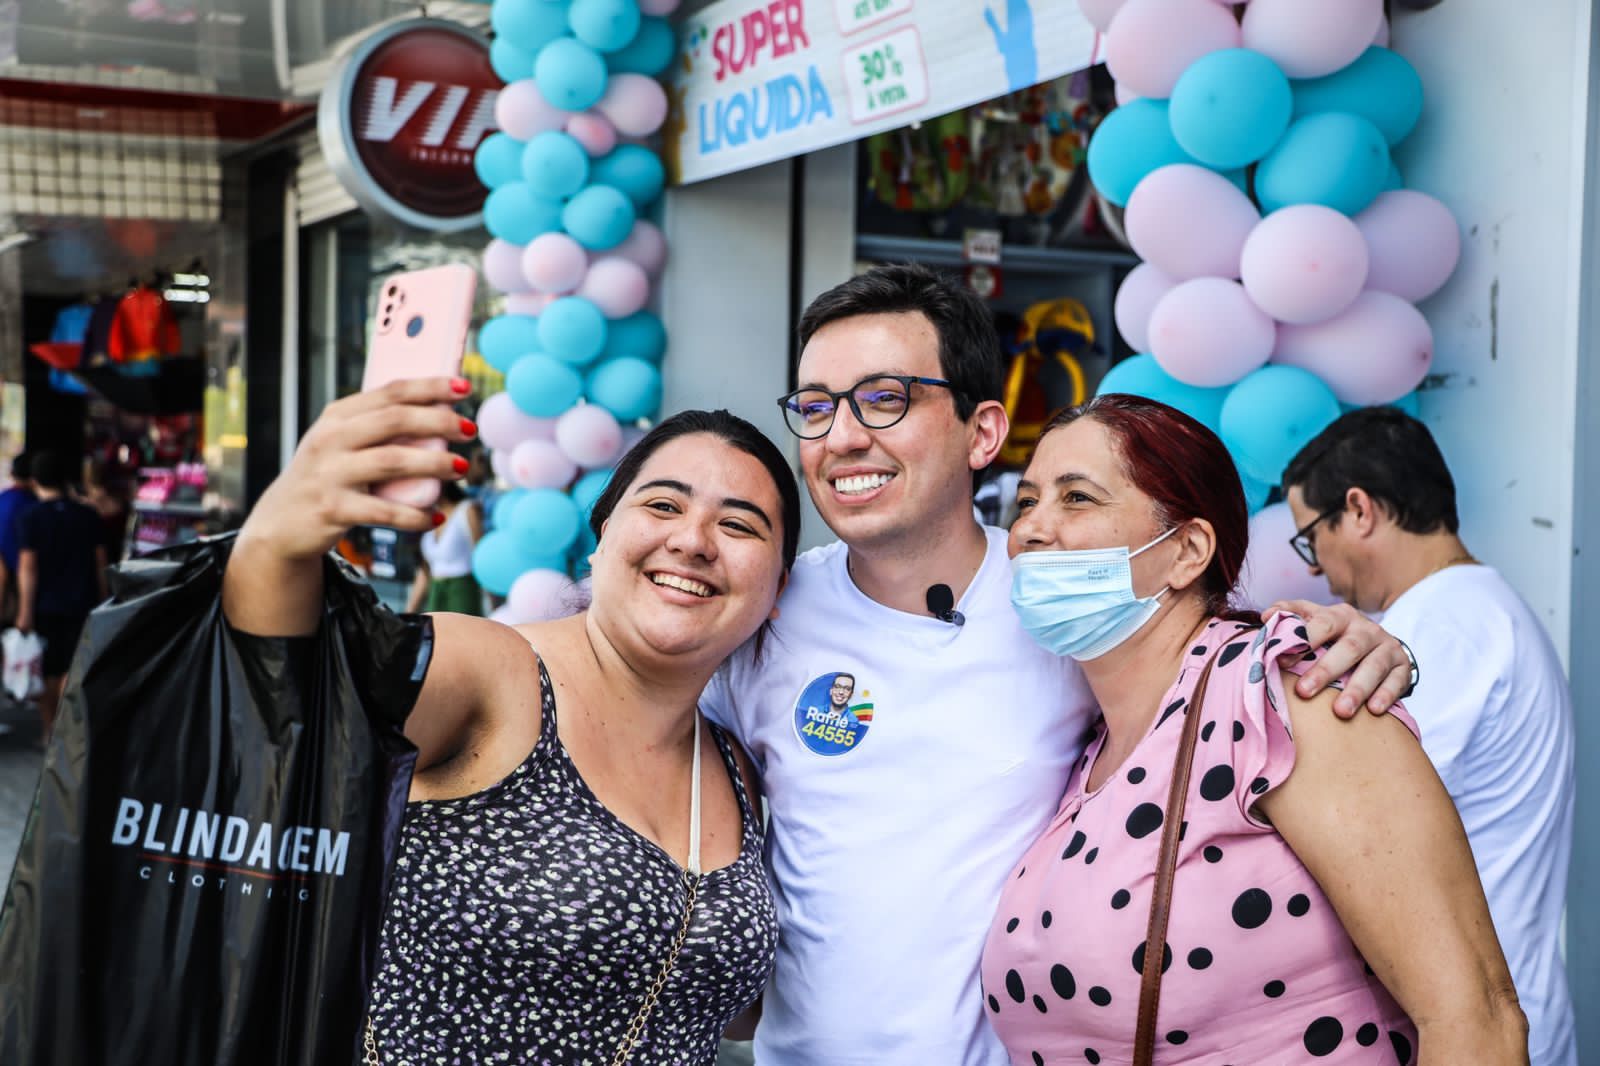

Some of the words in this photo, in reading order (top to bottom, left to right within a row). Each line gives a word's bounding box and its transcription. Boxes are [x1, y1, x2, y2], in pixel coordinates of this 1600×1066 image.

[713, 0, 809, 82] SUPER
[699, 65, 832, 154] LIQUIDA
[802, 721, 856, 746] 44555
[140, 866, 309, 901] CLOTHIG
